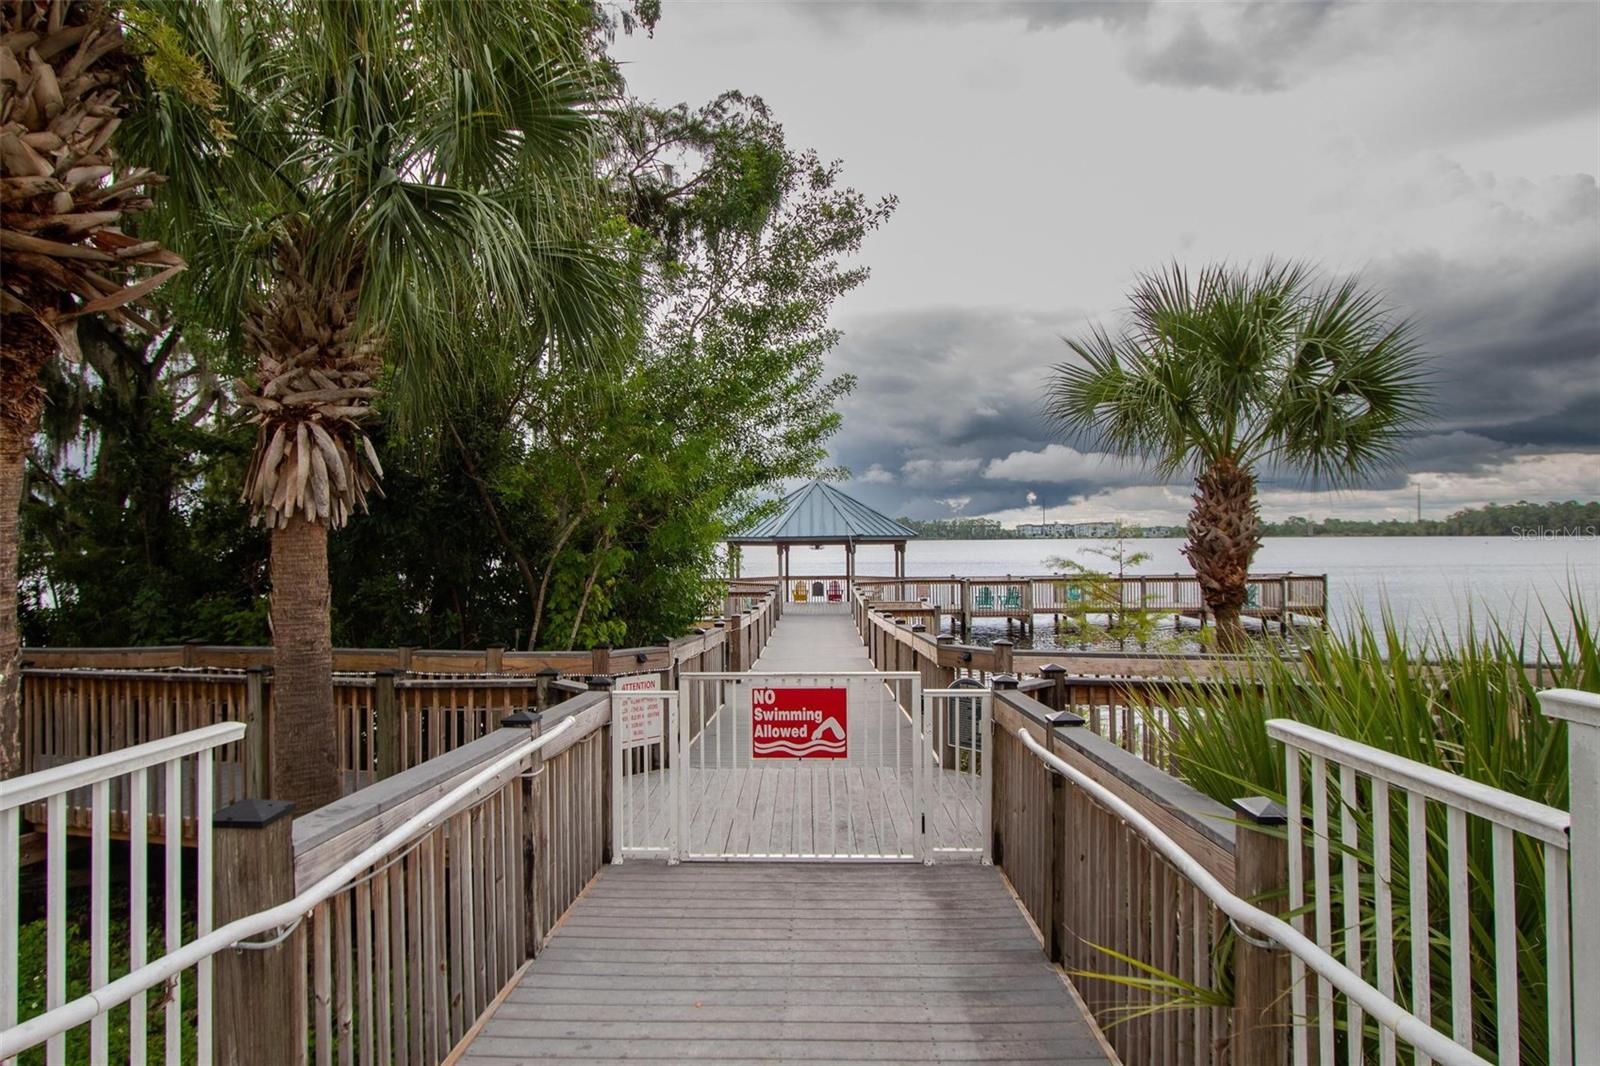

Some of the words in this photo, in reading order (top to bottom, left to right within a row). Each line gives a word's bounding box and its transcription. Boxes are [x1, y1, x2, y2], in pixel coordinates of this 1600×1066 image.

[622, 680, 656, 691] ATTENTION
[753, 689, 776, 705] NO
[754, 707, 823, 724] Swimming
[754, 724, 808, 738] Allowed
